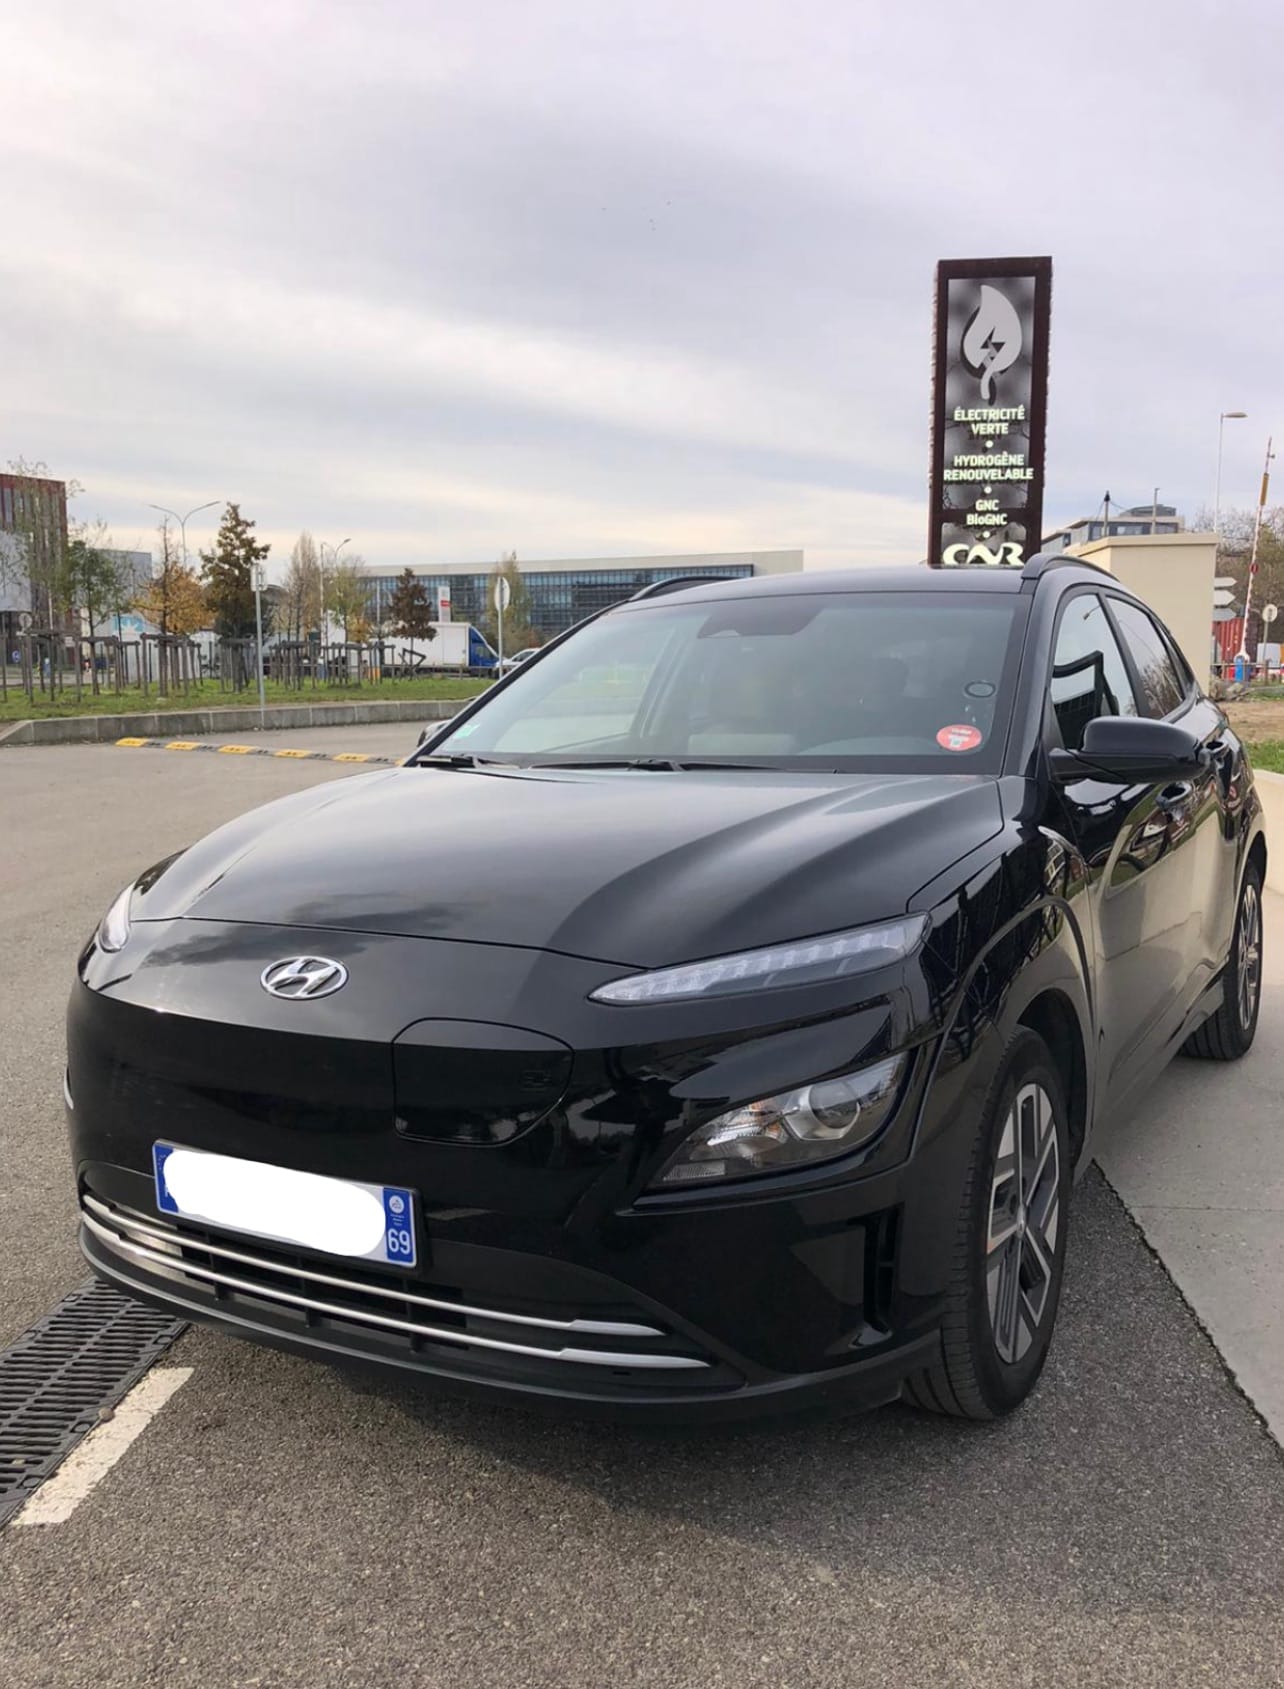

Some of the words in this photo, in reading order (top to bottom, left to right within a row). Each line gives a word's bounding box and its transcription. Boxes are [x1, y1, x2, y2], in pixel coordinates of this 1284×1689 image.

[954, 405, 1025, 421] ÉLECTRICITÉ
[971, 423, 1009, 435] VERTE
[953, 452, 1025, 467] HYDROGÈNE
[943, 468, 1034, 481] RENOUVELABLE
[975, 499, 1000, 511] GNC
[388, 1228, 410, 1254] 69
